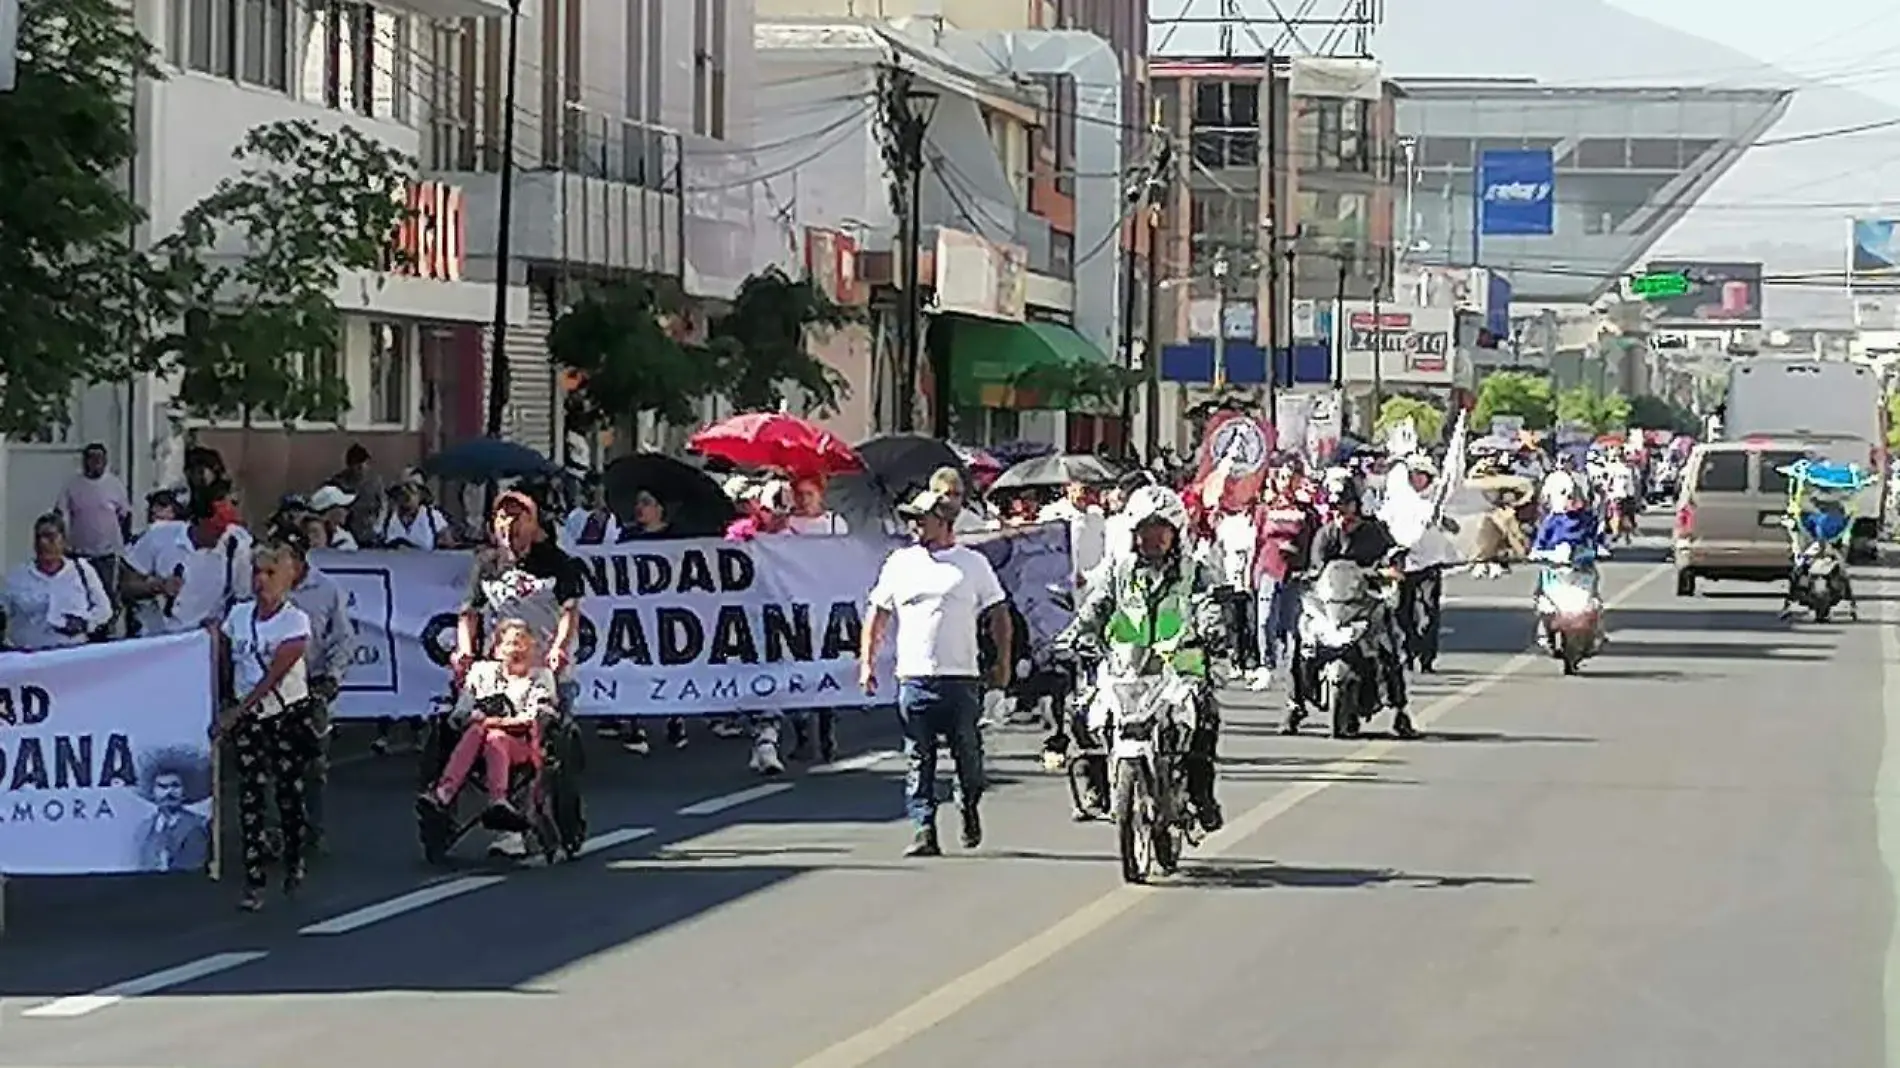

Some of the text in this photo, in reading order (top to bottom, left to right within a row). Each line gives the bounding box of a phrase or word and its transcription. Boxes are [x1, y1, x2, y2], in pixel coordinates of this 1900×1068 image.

[577, 548, 756, 597] NIDAD
[650, 672, 842, 700] ZAMORA
[0, 733, 138, 790] ANA
[0, 798, 115, 822] MORA
